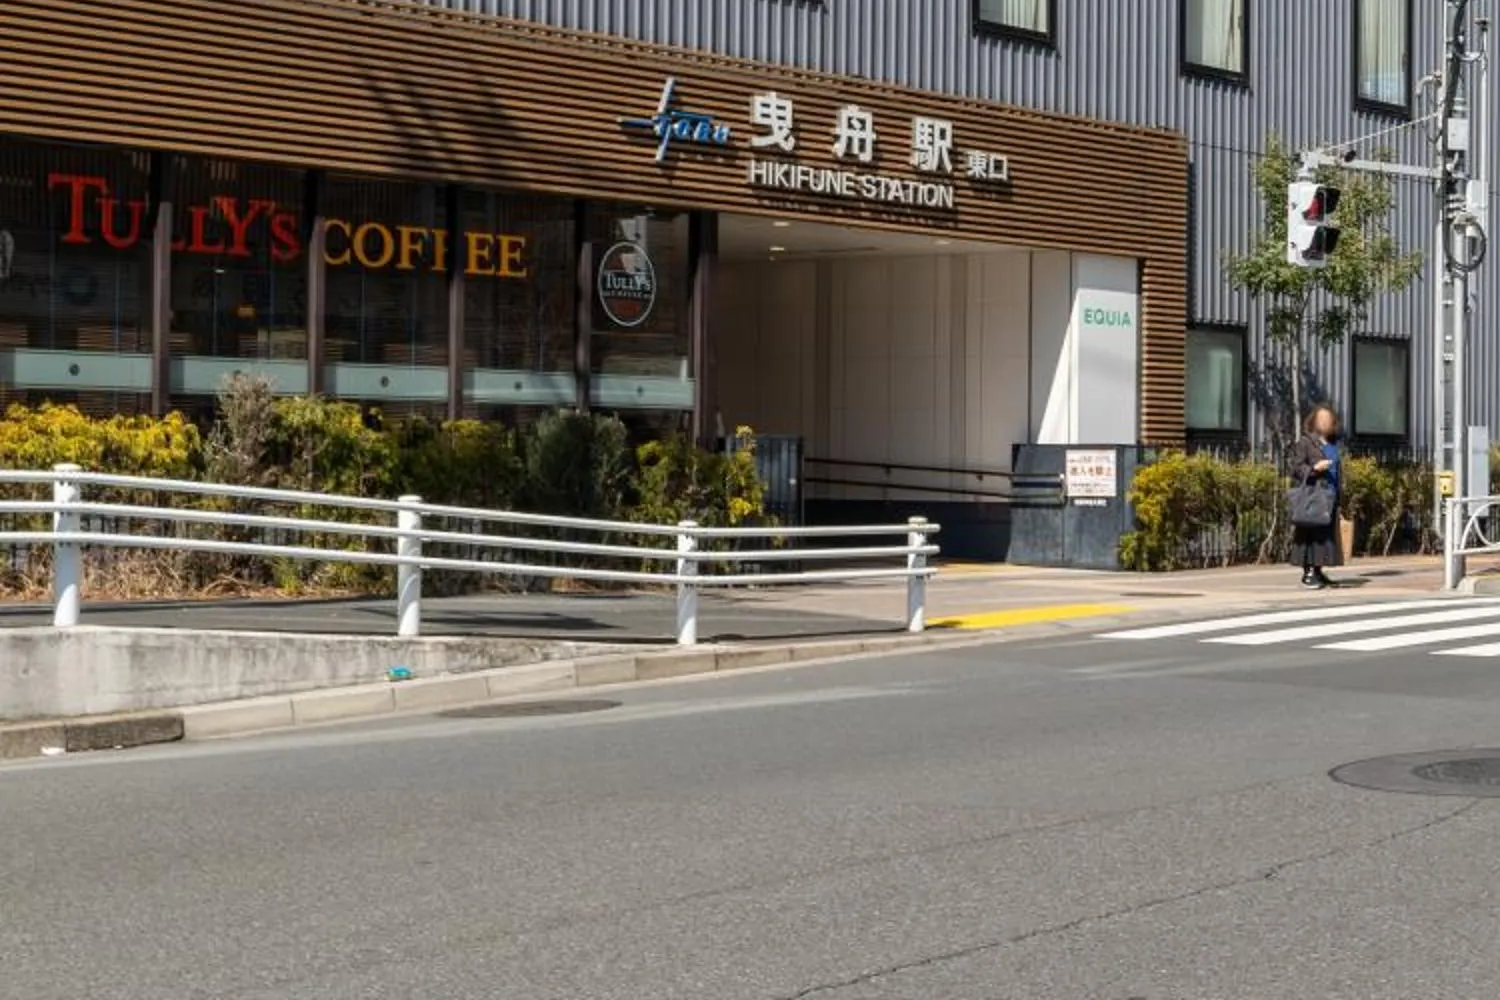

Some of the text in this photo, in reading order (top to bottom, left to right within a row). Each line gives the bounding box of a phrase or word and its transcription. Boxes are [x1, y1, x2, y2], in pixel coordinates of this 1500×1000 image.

[750, 92, 1009, 181] 曳舟駅 東口
[48, 172, 301, 261] TULY'S
[750, 159, 953, 208] HIKIFUNE STATION
[1084, 308, 1132, 327] EQUIA
